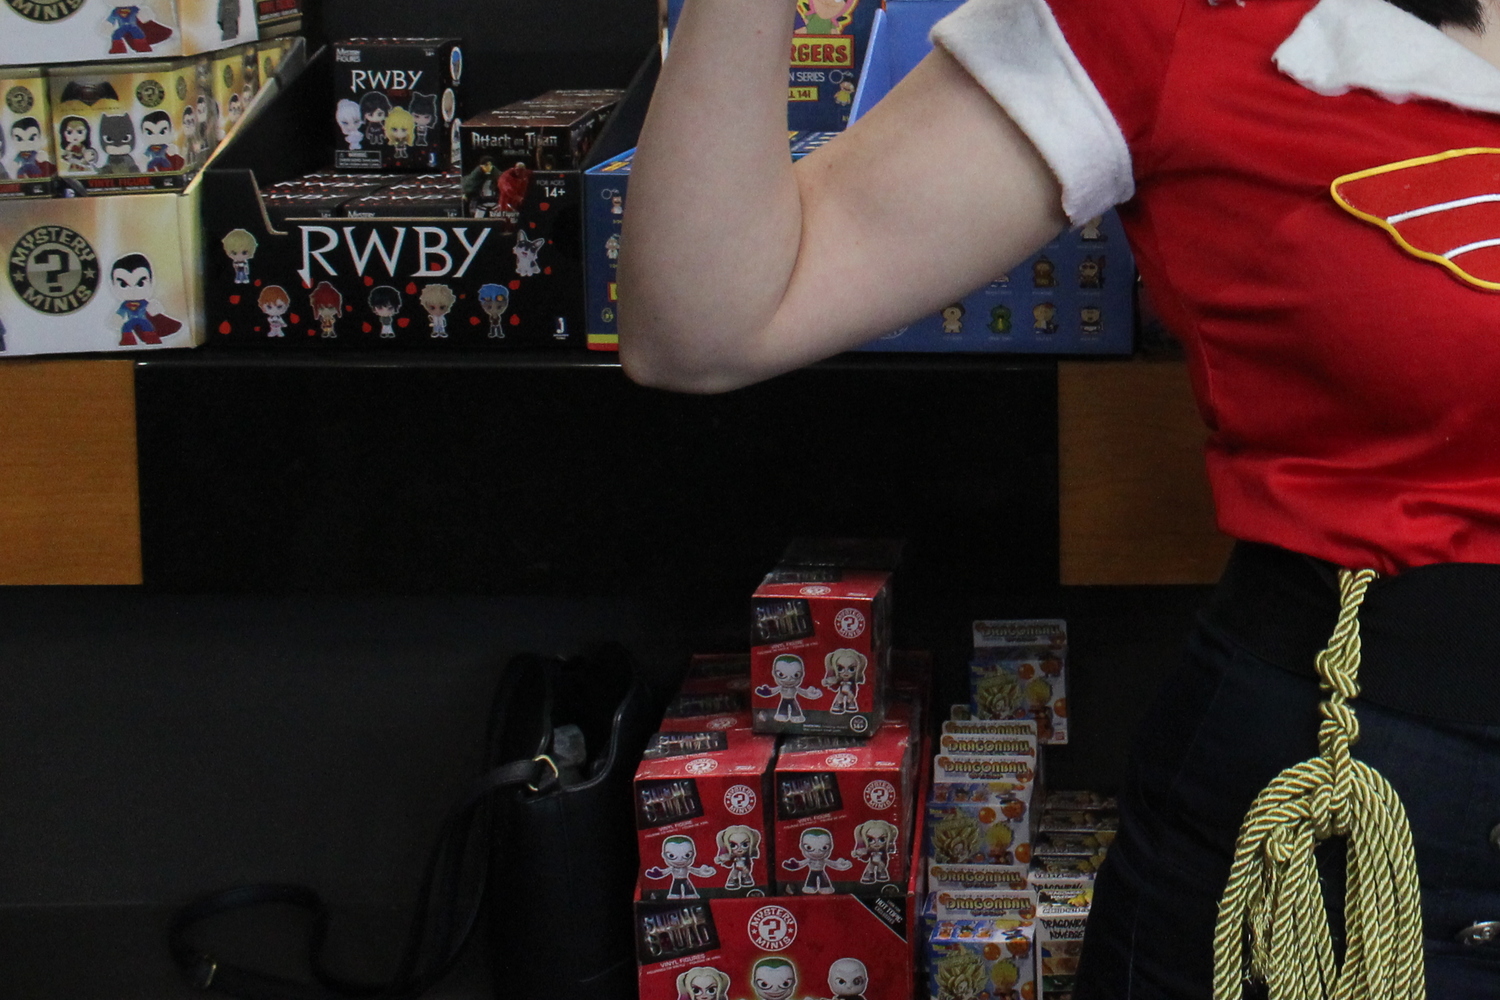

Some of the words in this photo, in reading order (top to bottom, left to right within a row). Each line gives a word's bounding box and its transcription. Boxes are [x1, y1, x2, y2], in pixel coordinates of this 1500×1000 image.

[350, 69, 423, 93] RWBY
[796, 72, 825, 82] SERIES
[472, 132, 511, 148] Attack
[544, 187, 565, 198] 14+
[10, 227, 96, 268] MYSTERY
[297, 225, 492, 288] RWBY
[22, 284, 93, 313] MINIS
[948, 740, 1029, 752] DRAGONBALL
[944, 762, 1027, 773] DRAGONBALL
[938, 872, 1021, 882] DRAGONBALL
[946, 898, 1031, 909] DRAGONBALL
[751, 907, 794, 927] MYSTERY
[755, 936, 791, 950] MINIS
[660, 960, 678, 968] VINYL
